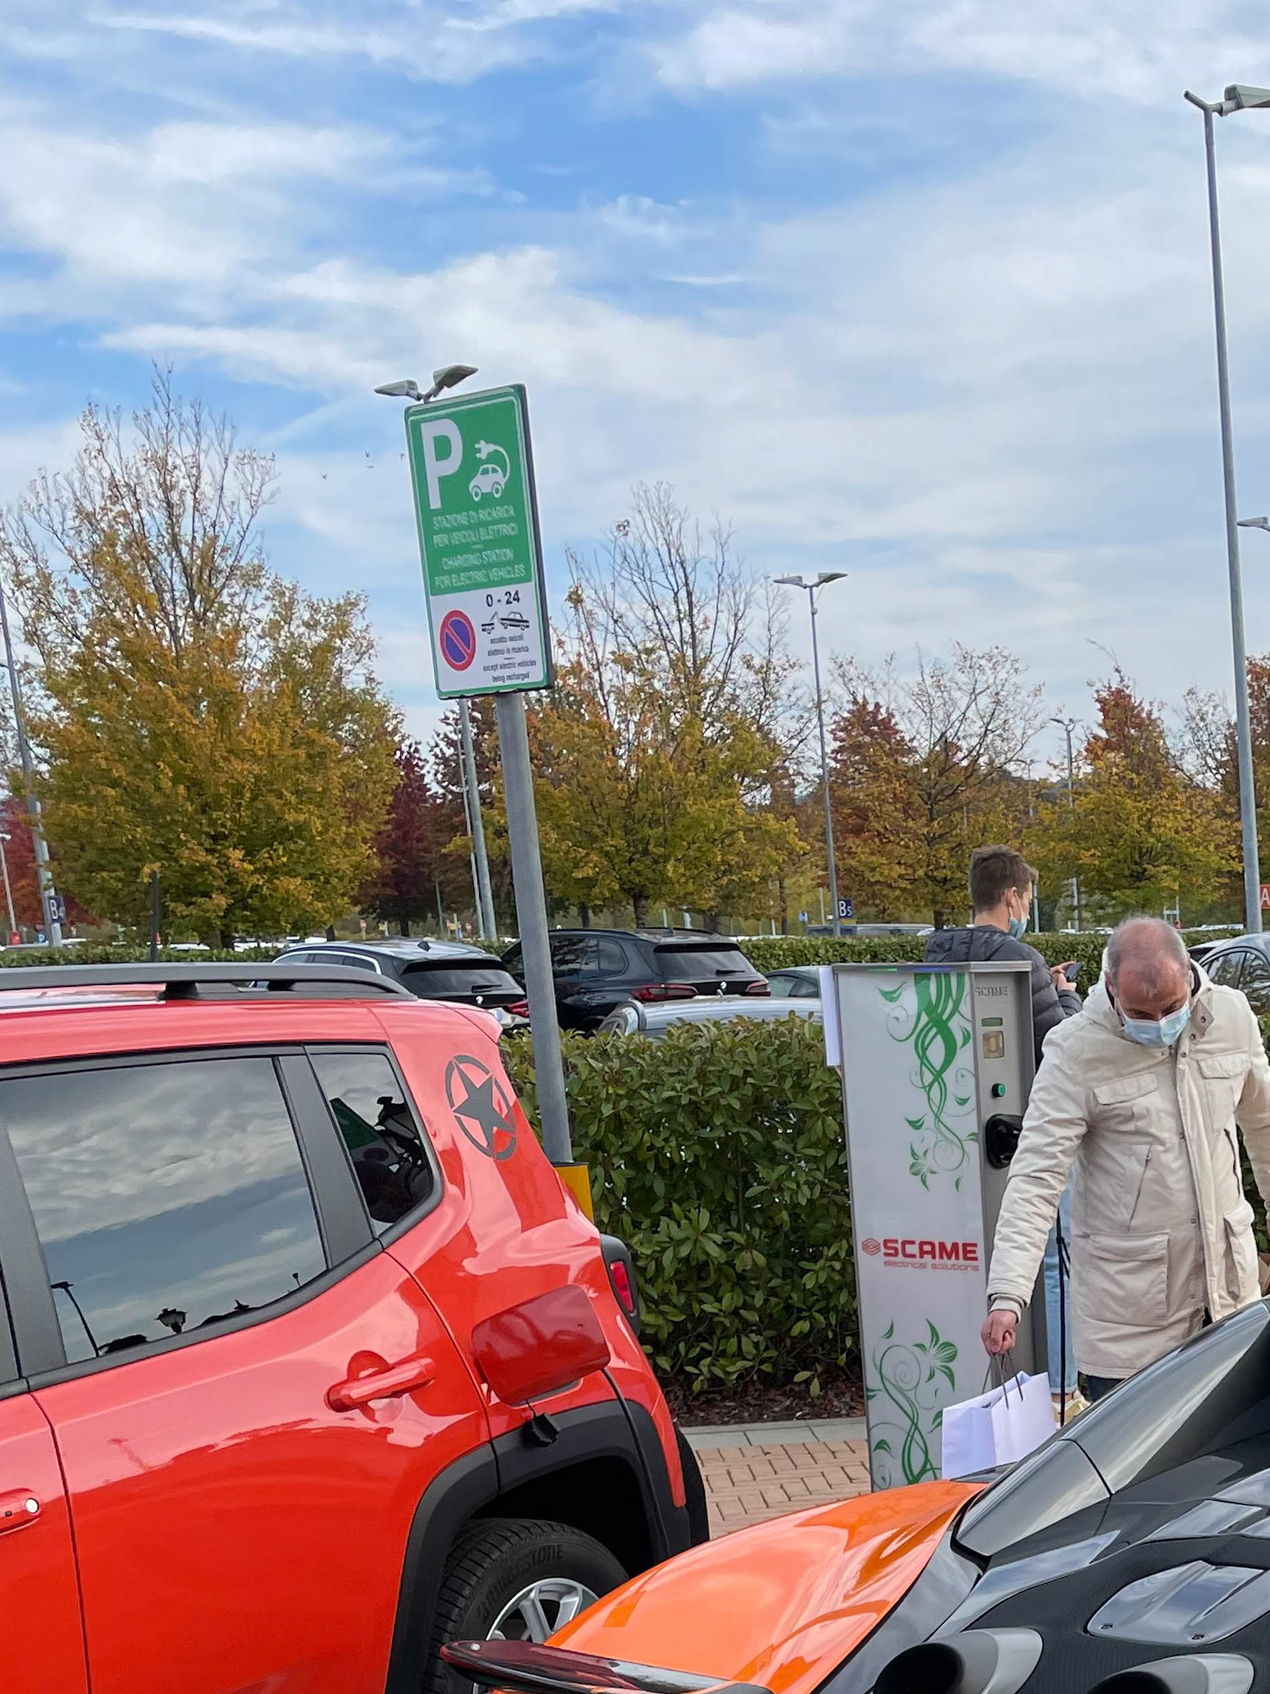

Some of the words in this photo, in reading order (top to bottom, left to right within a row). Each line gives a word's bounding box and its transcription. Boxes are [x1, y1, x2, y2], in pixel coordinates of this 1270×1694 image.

[420, 418, 463, 510] P
[433, 512, 469, 530] STAZIONE
[469, 510, 478, 523] DI
[478, 505, 515, 521] RICARICA
[433, 533, 449, 548] PER
[449, 528, 479, 545] VEICOLI
[479, 522, 518, 541] ELETTRICI
[442, 553, 481, 570] CHARGING
[482, 548, 514, 564] STATION
[434, 574, 451, 589] FOR
[451, 569, 488, 587] ELECTRIC
[488, 563, 526, 581] VEHICLES
[486, 594, 493, 607] 0
[504, 590, 520, 605] 24
[839, 900, 853, 917] B5
[975, 986, 1008, 997] SCAME
[882, 1238, 978, 1261] SCAME
[883, 1260, 927, 1269] electrical
[931, 1262, 979, 1272] solutions
